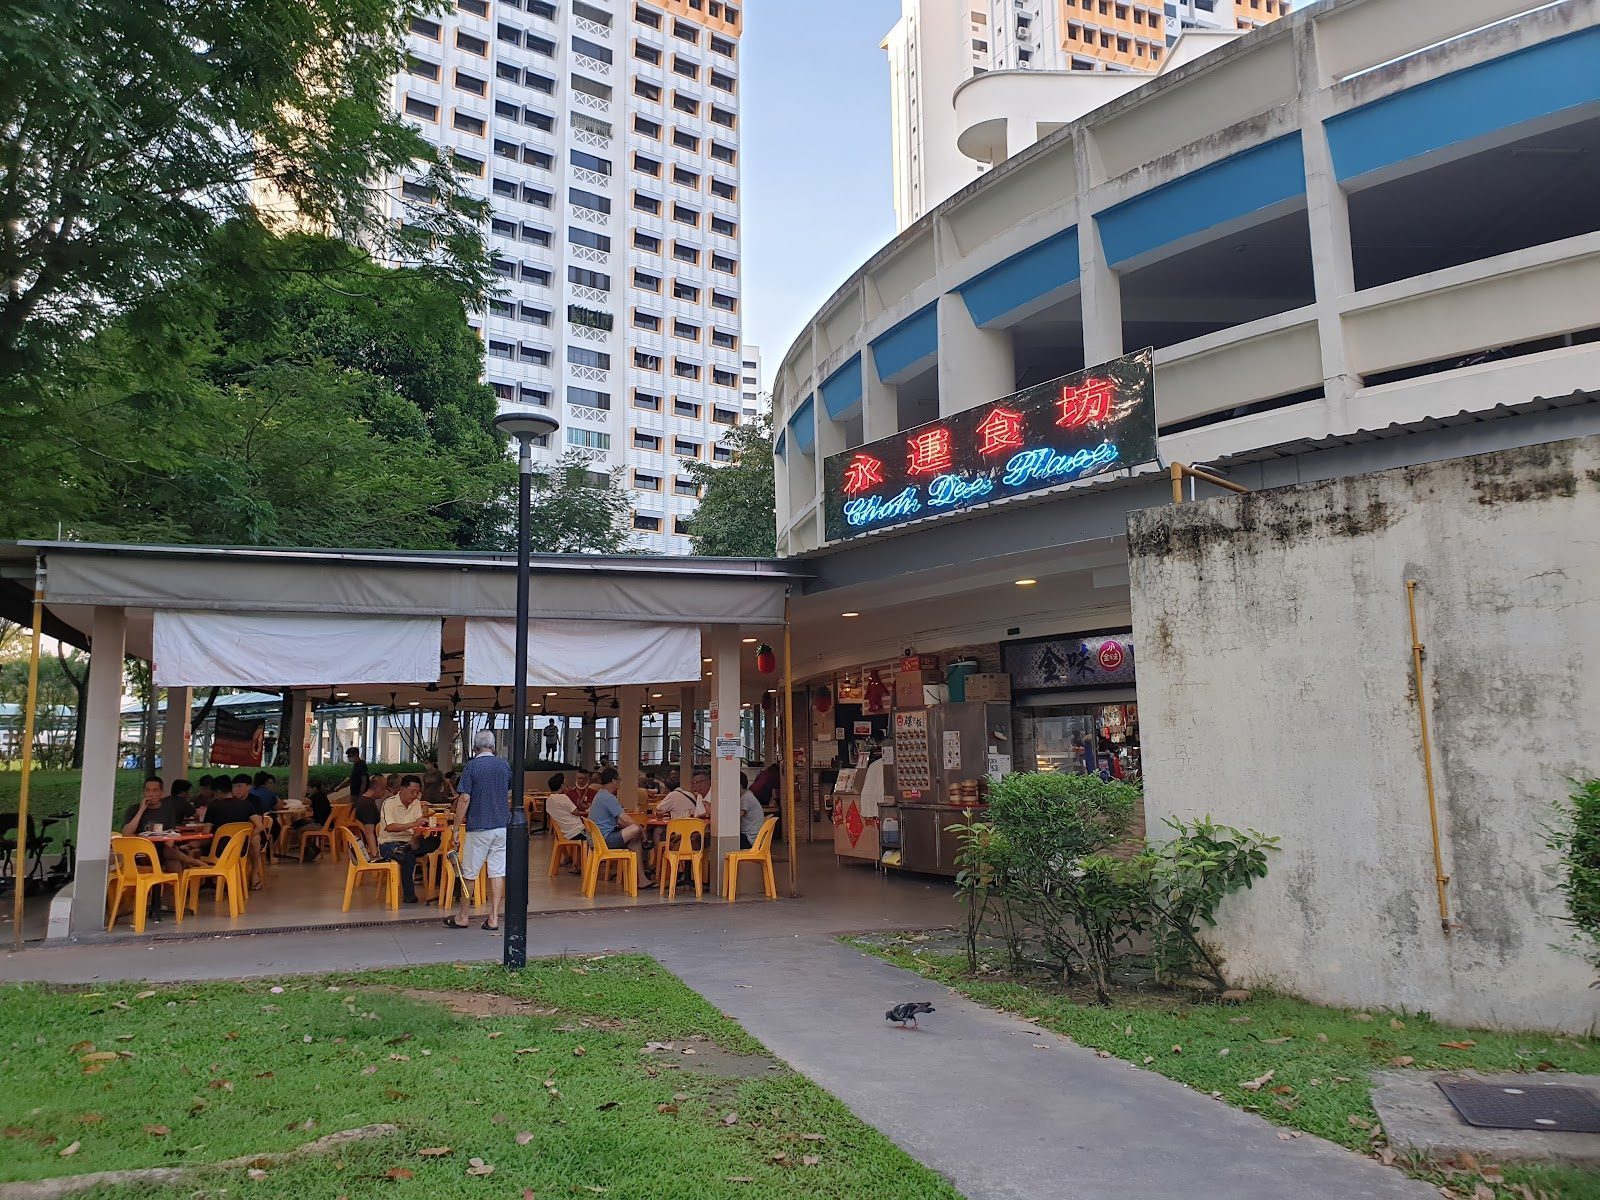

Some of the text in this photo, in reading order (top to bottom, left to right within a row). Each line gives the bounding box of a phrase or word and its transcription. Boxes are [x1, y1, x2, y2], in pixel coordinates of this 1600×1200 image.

[843, 377, 1119, 495] 永運食坊
[928, 474, 994, 507] Dee
[1003, 443, 1119, 486] Place
